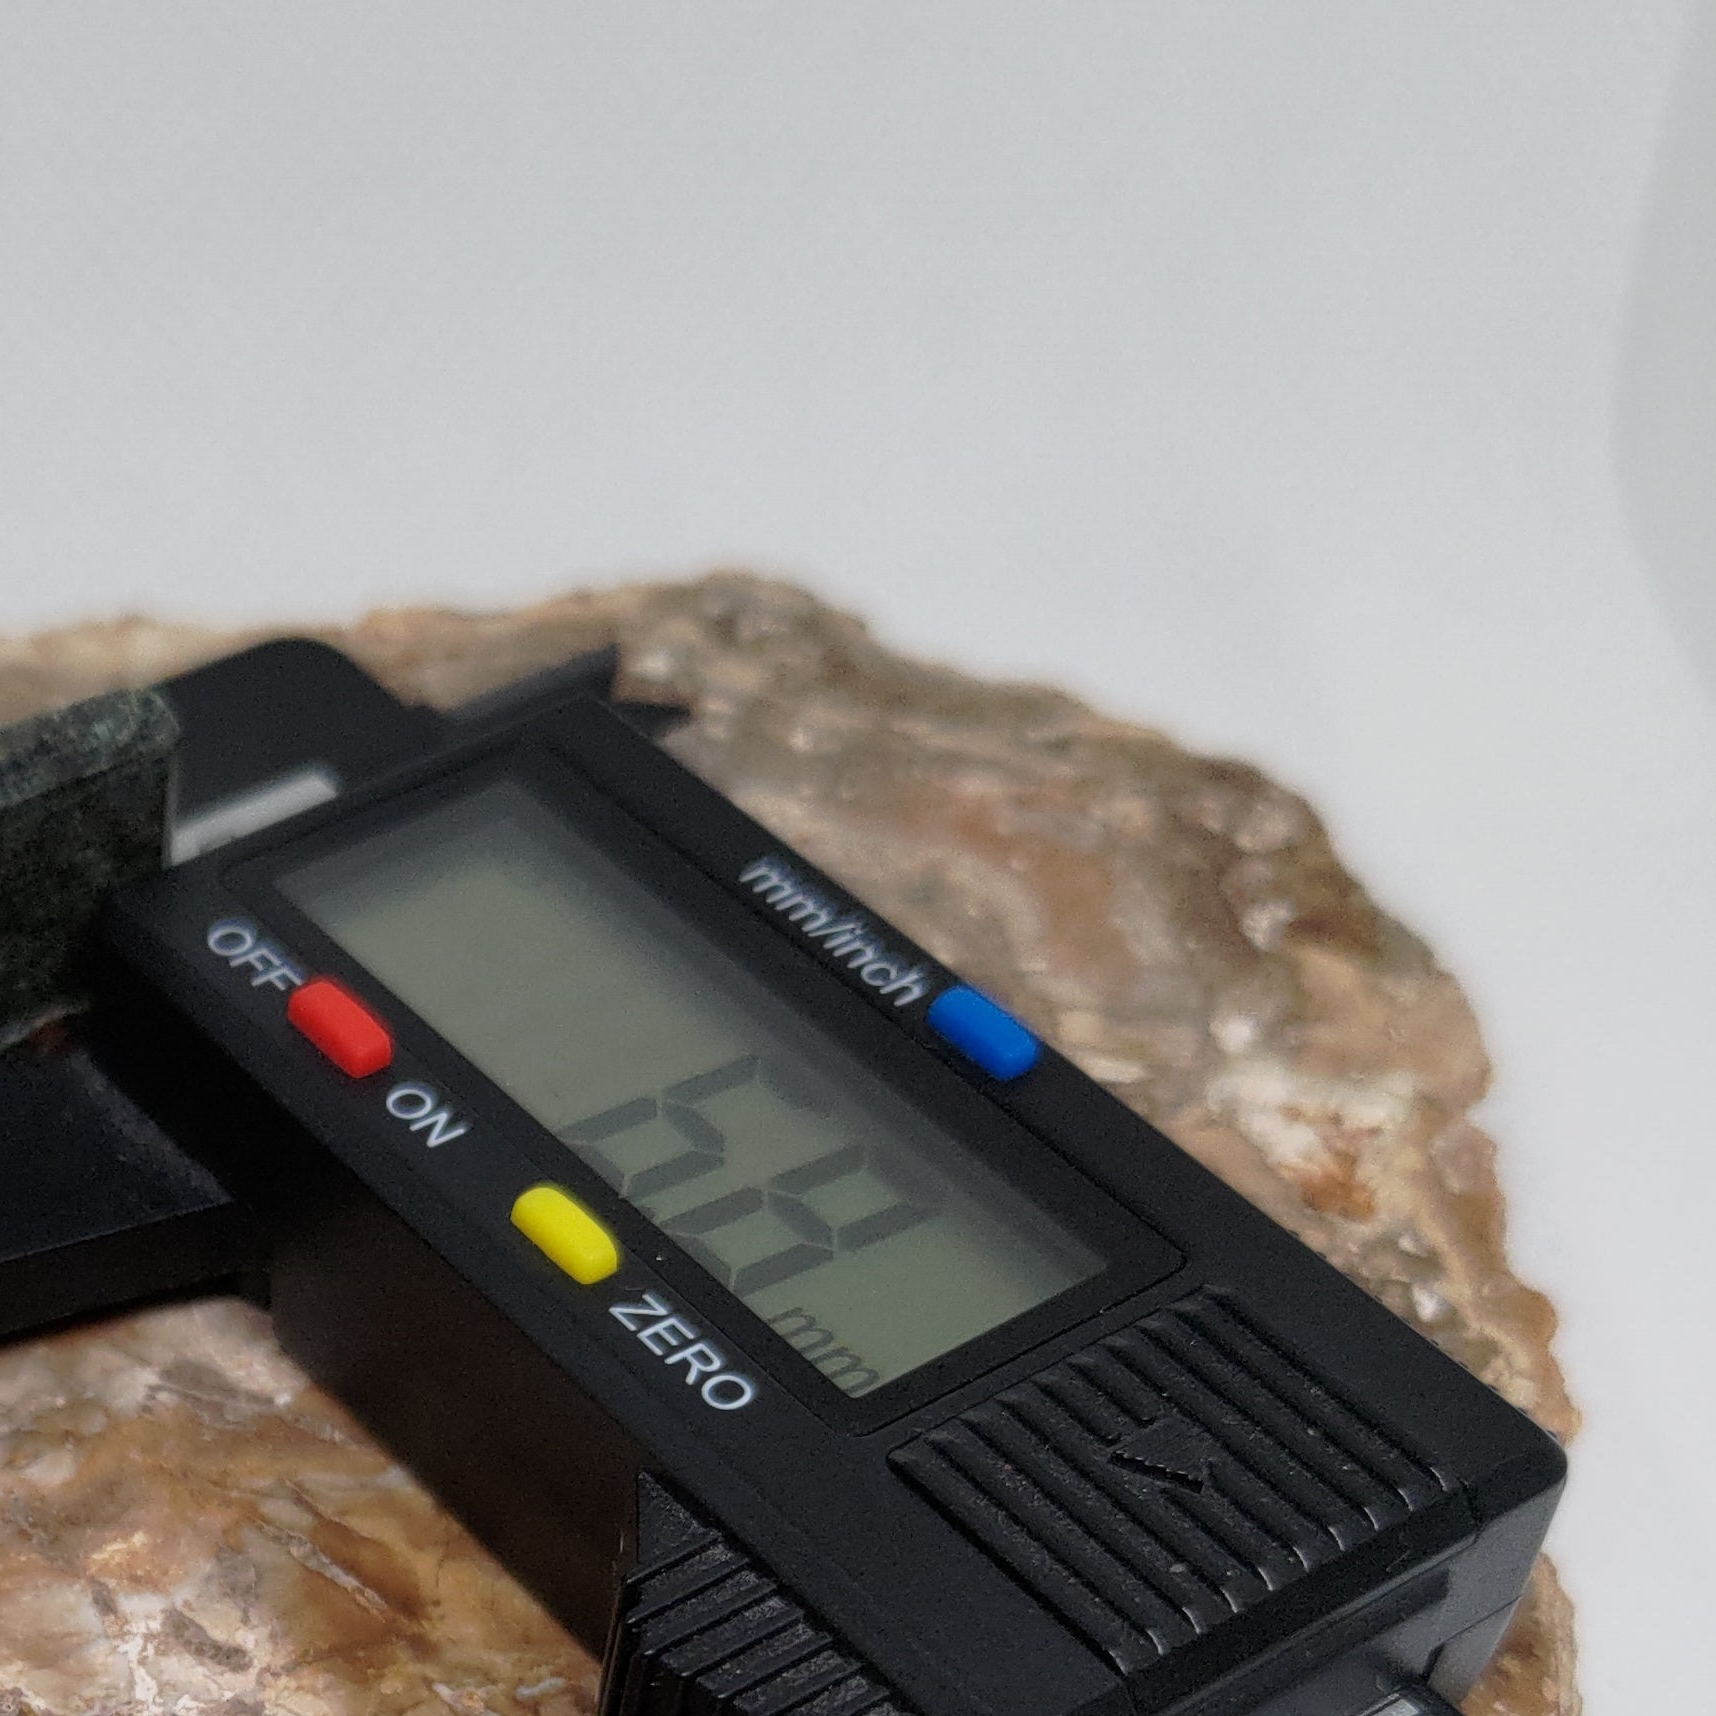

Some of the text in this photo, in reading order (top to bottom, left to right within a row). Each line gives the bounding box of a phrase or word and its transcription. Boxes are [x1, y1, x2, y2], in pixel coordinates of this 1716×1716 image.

[207, 918, 305, 992] OFF
[739, 855, 927, 1006] mm/inch
[386, 1087, 466, 1149] ON
[609, 1293, 754, 1411] ZERO
